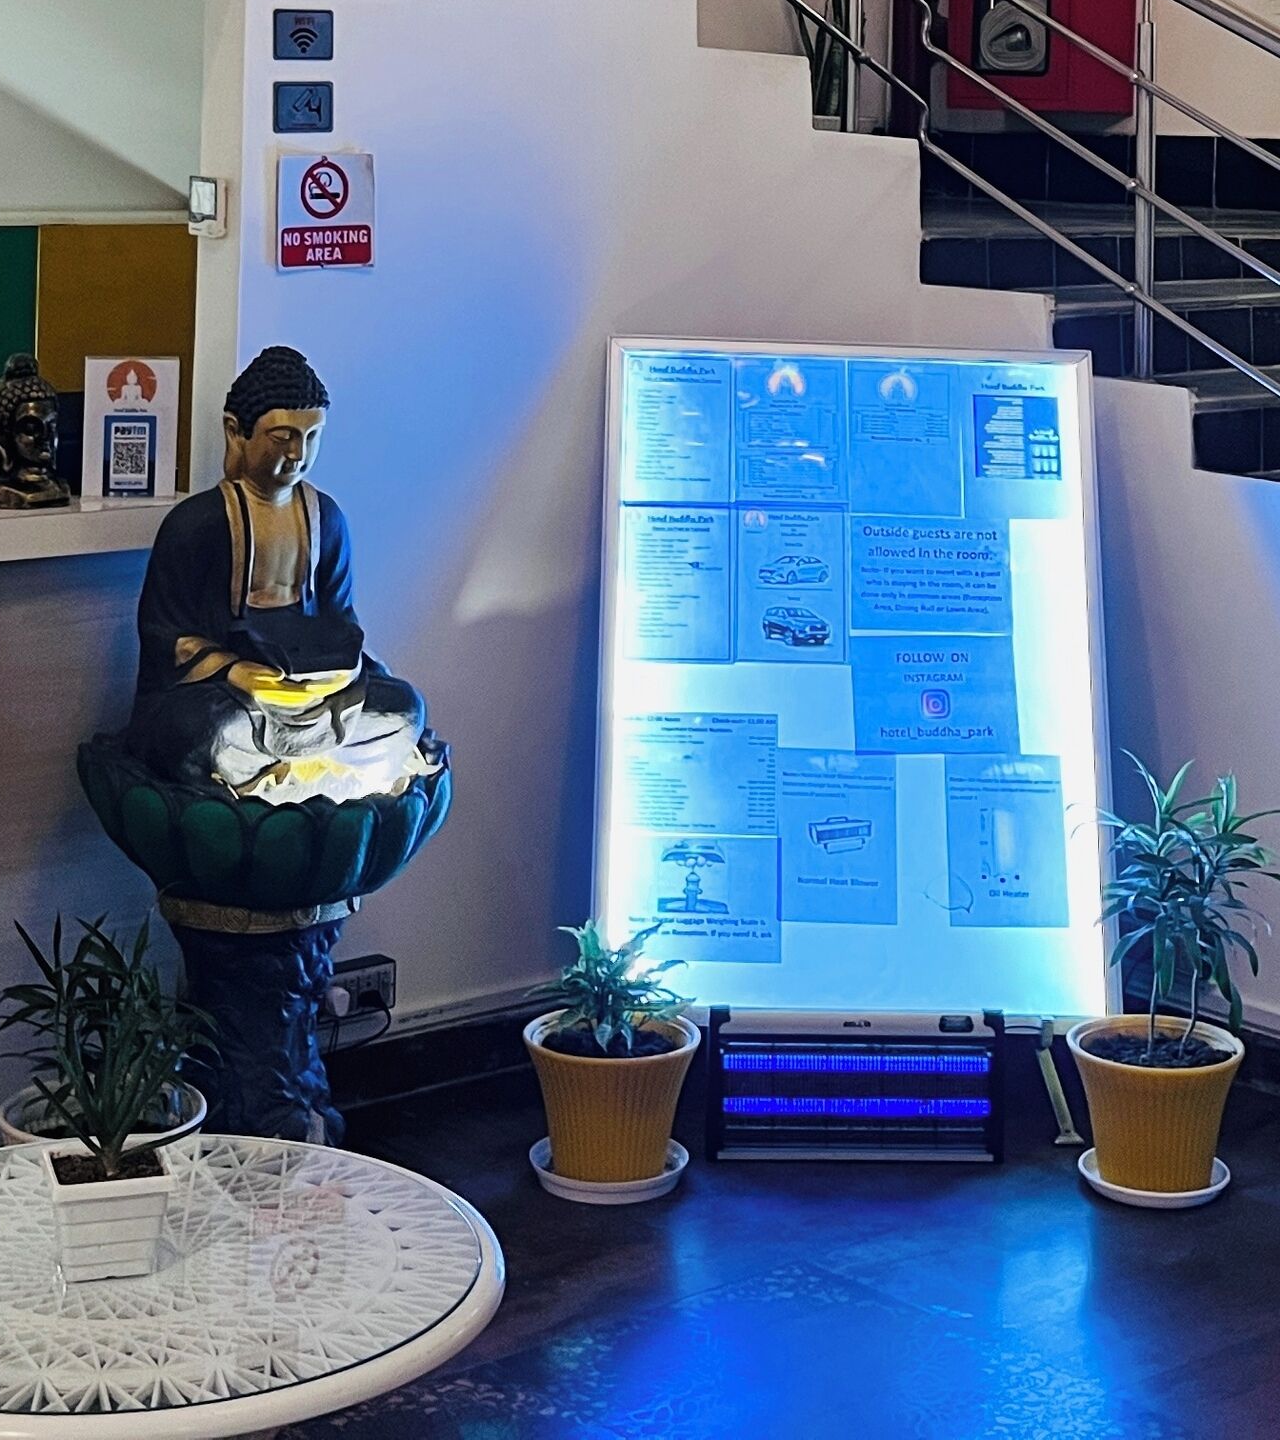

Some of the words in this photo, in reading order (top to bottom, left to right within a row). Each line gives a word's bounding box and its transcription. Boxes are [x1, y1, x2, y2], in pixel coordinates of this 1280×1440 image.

[283, 233, 301, 247] NO
[304, 228, 369, 246] SMOKING
[306, 247, 343, 261] AREA
[863, 525, 909, 538] Outside
[912, 528, 951, 540] guests
[953, 530, 973, 540] are
[977, 530, 998, 541] not
[868, 546, 915, 558] allowed
[919, 547, 930, 558] in
[933, 548, 953, 559] the
[956, 550, 993, 560] room.
[927, 580, 940, 588] the
[896, 653, 945, 663] FOLLOW
[950, 653, 969, 663] ON
[903, 673, 964, 683] INSTAGRAM
[880, 726, 994, 740] hotel_buddha_park
